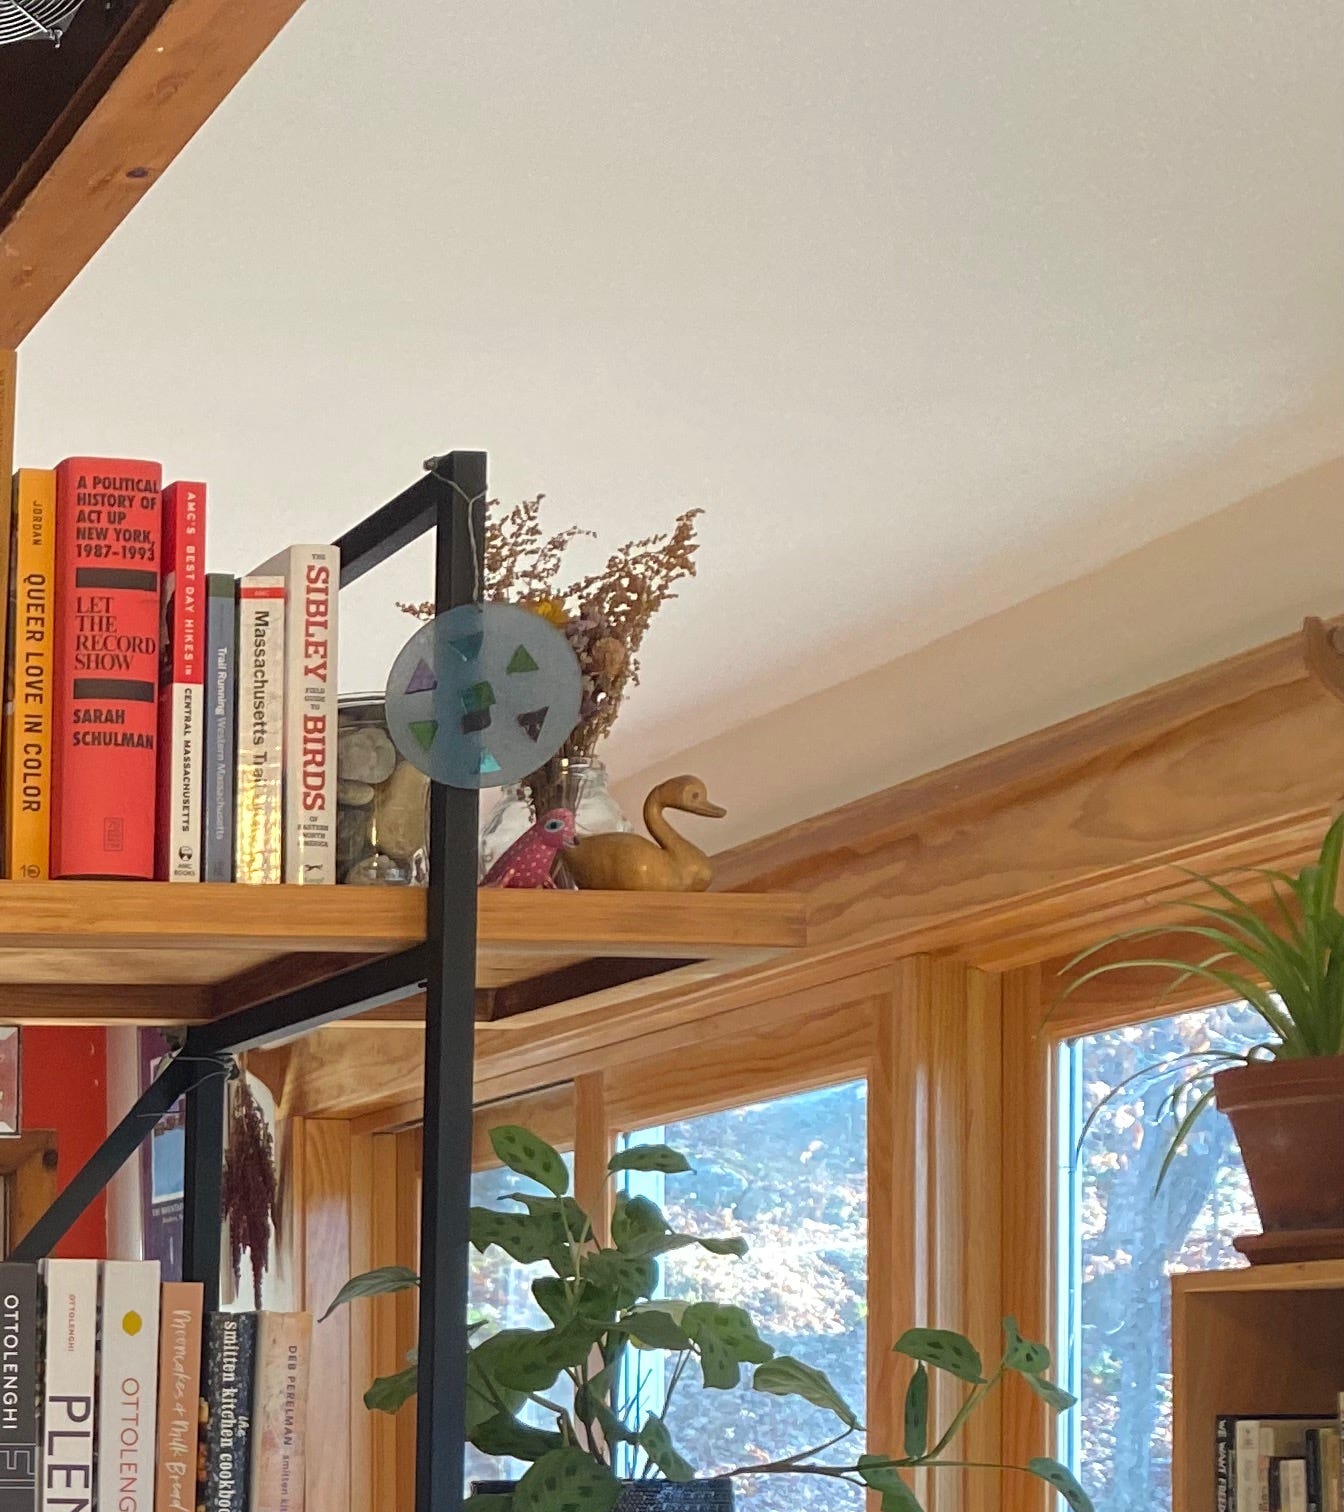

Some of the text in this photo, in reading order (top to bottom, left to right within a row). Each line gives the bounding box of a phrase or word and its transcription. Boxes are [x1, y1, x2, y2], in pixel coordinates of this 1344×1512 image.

[76, 476, 160, 494] A POLITICAL
[76, 493, 157, 510] HISTORY OF
[186, 491, 196, 535] AMC'S
[31, 500, 43, 546] JORDAN
[76, 510, 127, 525] ACT UP
[76, 527, 156, 547] NEW YORK,
[76, 544, 155, 562] 1987-1993
[185, 545, 196, 580] BEST
[75, 596, 114, 615] LET
[184, 586, 195, 613] DAY
[75, 616, 118, 634] THE
[304, 564, 330, 683] SIBLEY
[75, 635, 156, 655] RECORD
[184, 618, 195, 661] HIKES
[74, 653, 134, 671] SHOW
[22, 573, 47, 812] QUEER LOVE IN COLOR
[73, 709, 125, 724] SARAH
[72, 731, 154, 750] SCHULMAN
[214, 647, 227, 840] Trail Running Western Massachusetts
[182, 688, 192, 832] CENTRAL MASSACHUSETTS
[303, 714, 326, 812] BIRDS
[2, 1294, 18, 1429] OTTOLENGHI
[1217, 1420, 1226, 1438] WE
[1217, 1441, 1227, 1474] WANT
